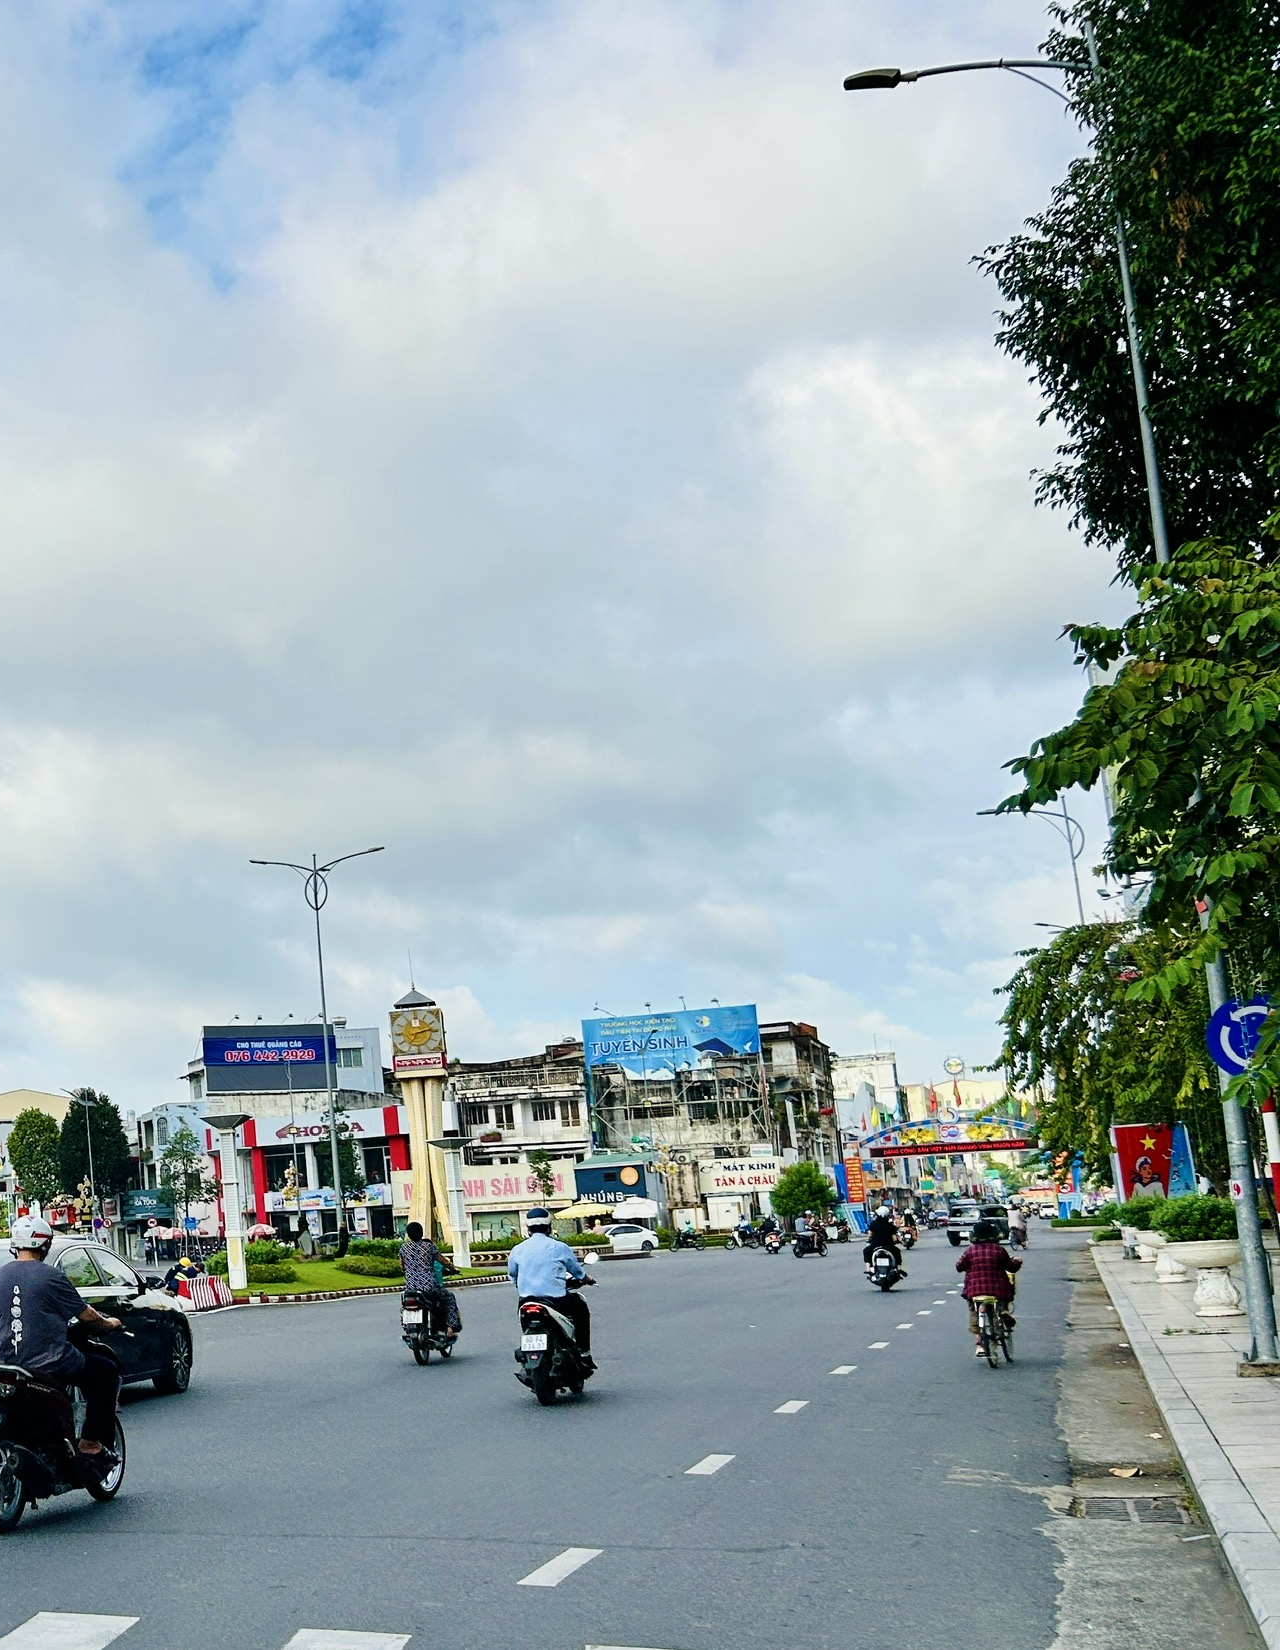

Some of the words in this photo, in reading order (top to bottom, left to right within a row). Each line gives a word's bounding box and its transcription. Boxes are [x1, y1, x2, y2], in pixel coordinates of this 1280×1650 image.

[250, 1040, 266, 1049] THUÊ
[267, 1039, 288, 1049] QUẢNG
[289, 1040, 302, 1048] CÁO
[590, 1035, 646, 1057] TUYỂN
[648, 1035, 689, 1051] SINH
[225, 1050, 251, 1062] 076
[253, 1050, 279, 1062] 442
[282, 1049, 315, 1061] 2929
[748, 1160, 776, 1171] KÍNH
[490, 1173, 520, 1197] SÀI
[714, 1174, 735, 1187] TÂN
[738, 1173, 746, 1186] Á
[747, 1172, 776, 1186] CHÂU
[580, 1188, 624, 1204] NHÚNG
